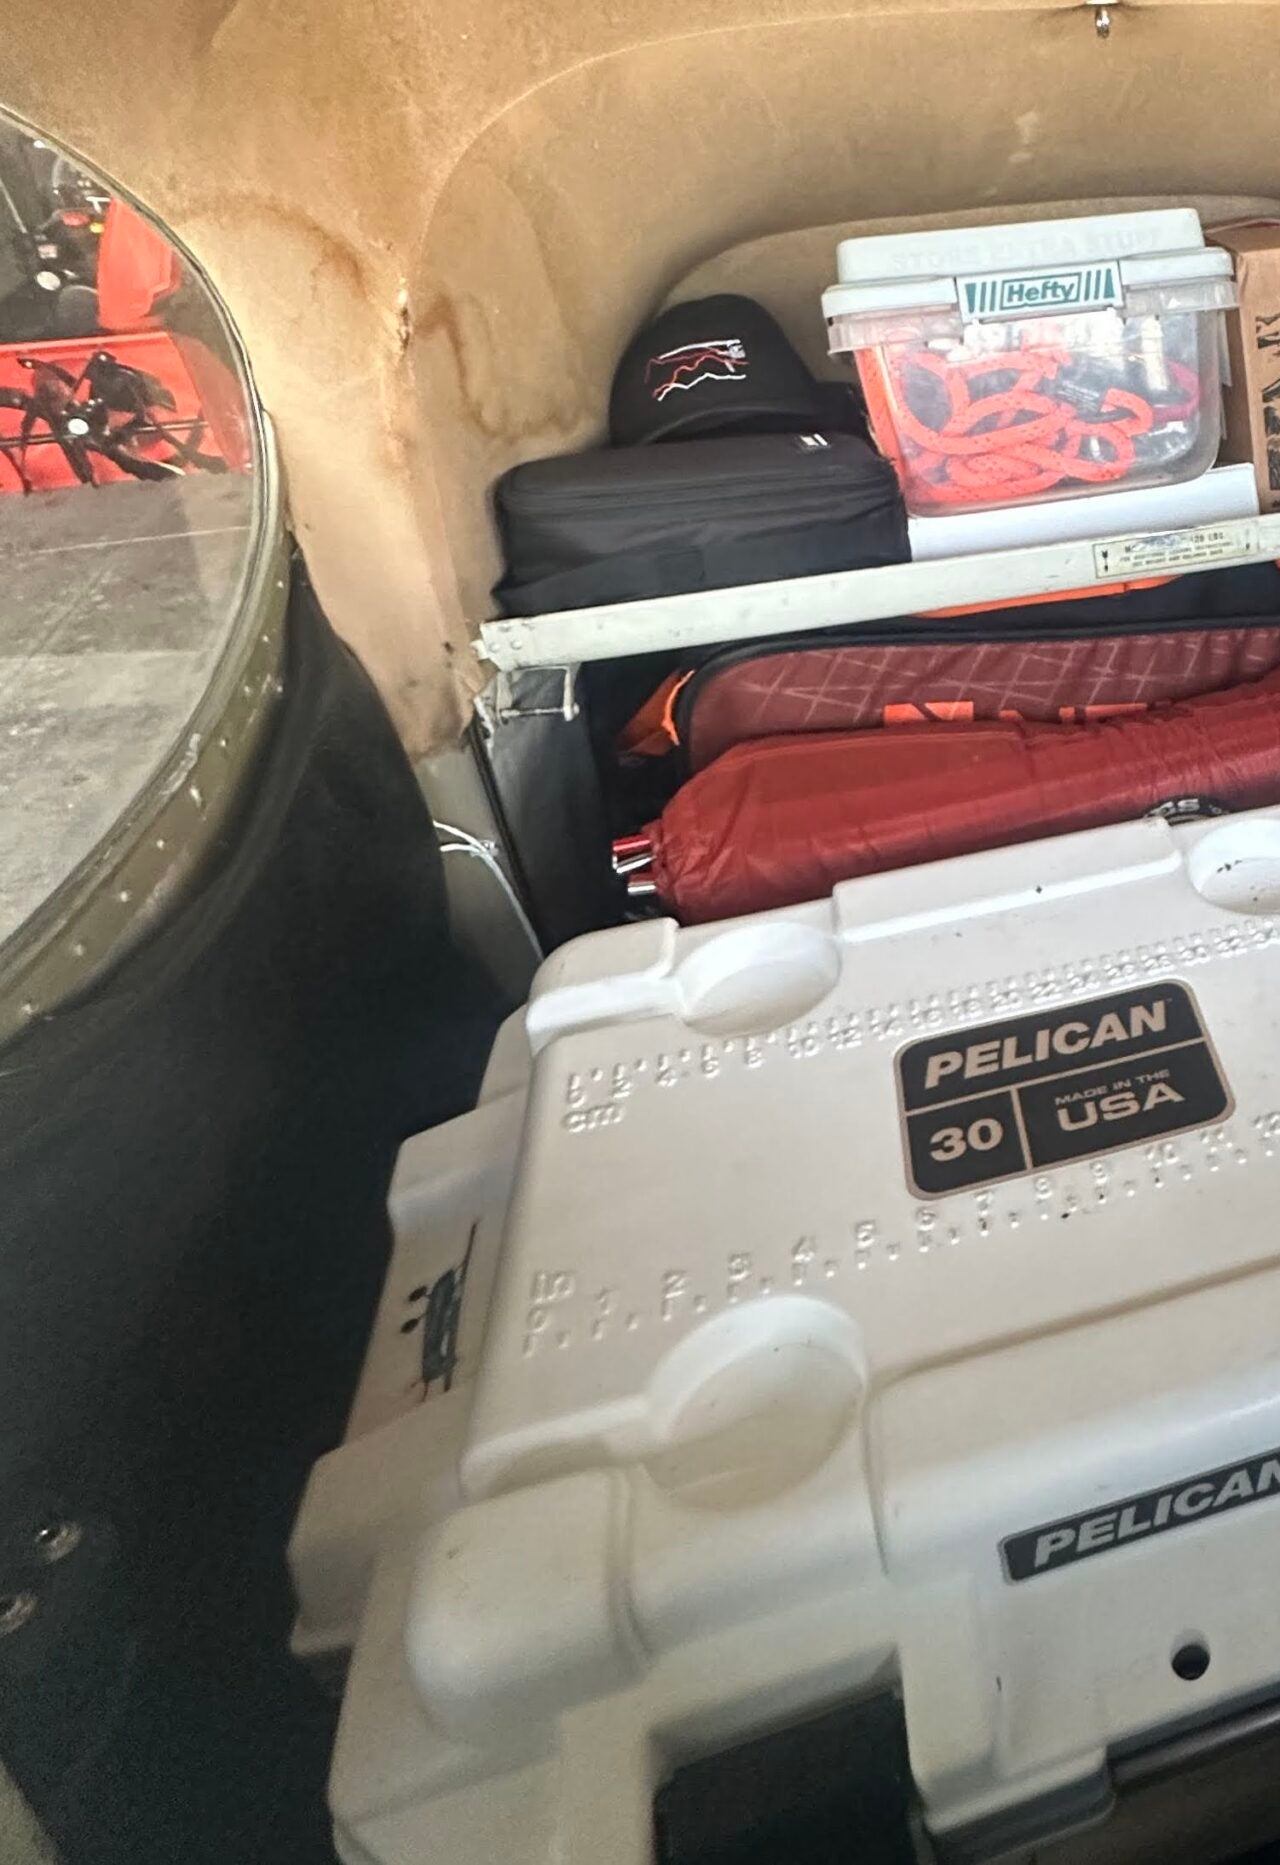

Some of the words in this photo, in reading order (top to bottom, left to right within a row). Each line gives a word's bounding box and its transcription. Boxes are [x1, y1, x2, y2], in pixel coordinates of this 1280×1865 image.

[1006, 281, 1075, 303] Hefty
[923, 999, 1167, 1090] PELICAN
[1055, 1085, 1108, 1105] MADE
[1113, 1078, 1131, 1090] IN
[1134, 1069, 1170, 1084] THE
[1057, 1082, 1186, 1132] USA
[929, 1117, 1004, 1162] 30
